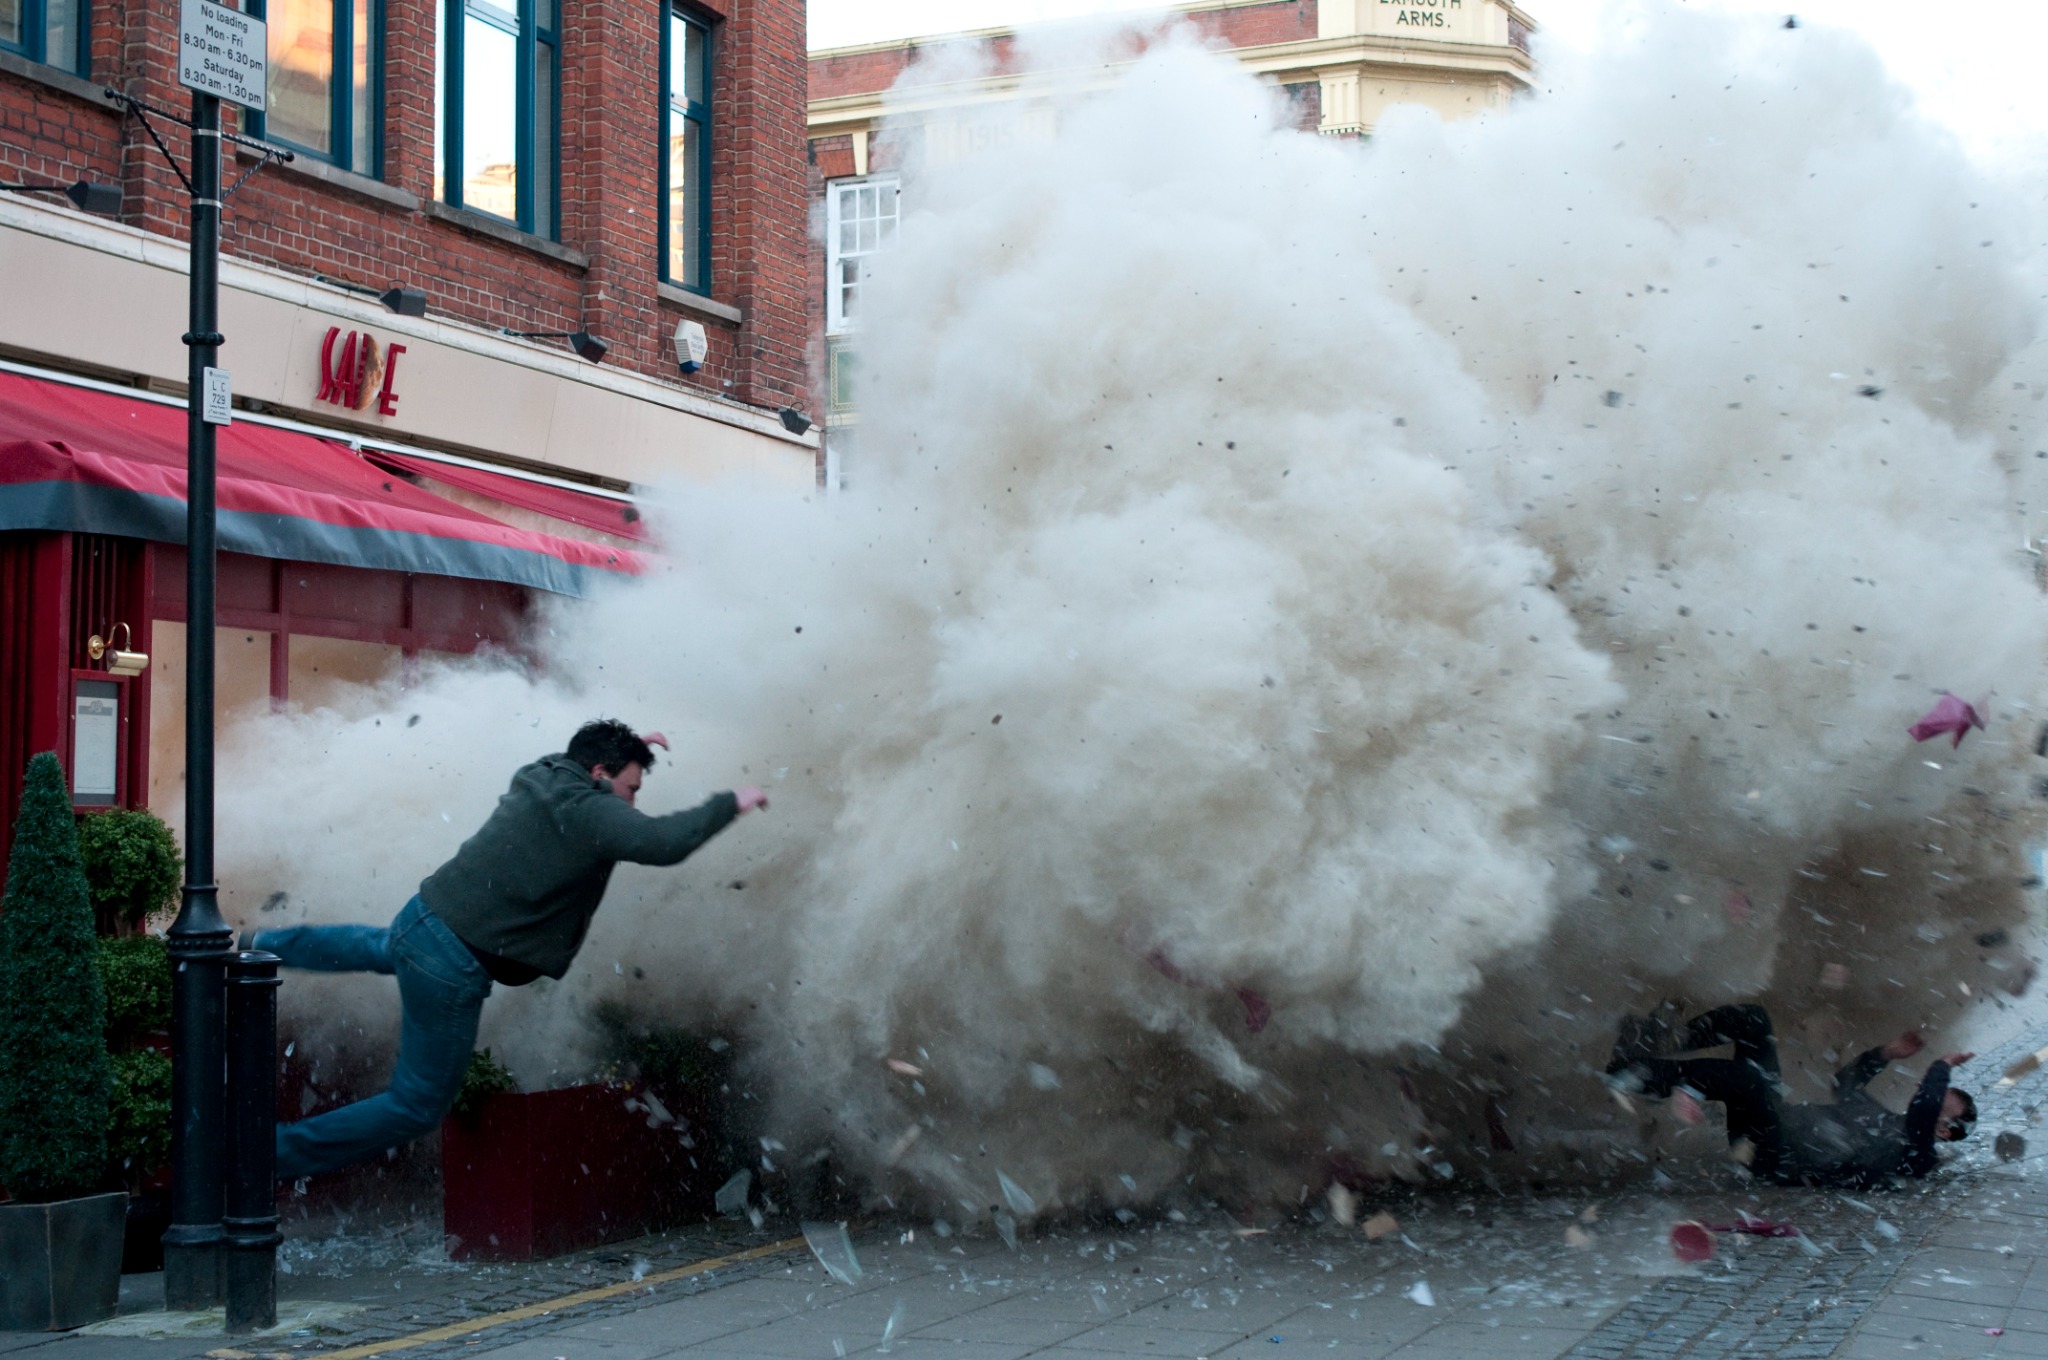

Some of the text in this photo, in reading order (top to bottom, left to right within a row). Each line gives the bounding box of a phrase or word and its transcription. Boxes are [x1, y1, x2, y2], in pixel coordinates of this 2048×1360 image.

[201, 4, 248, 34] No loading
[206, 24, 225, 40] Mon
[231, 34, 243, 48] Fri
[203, 58, 244, 84] Saturday
[212, 393, 226, 405] 729
